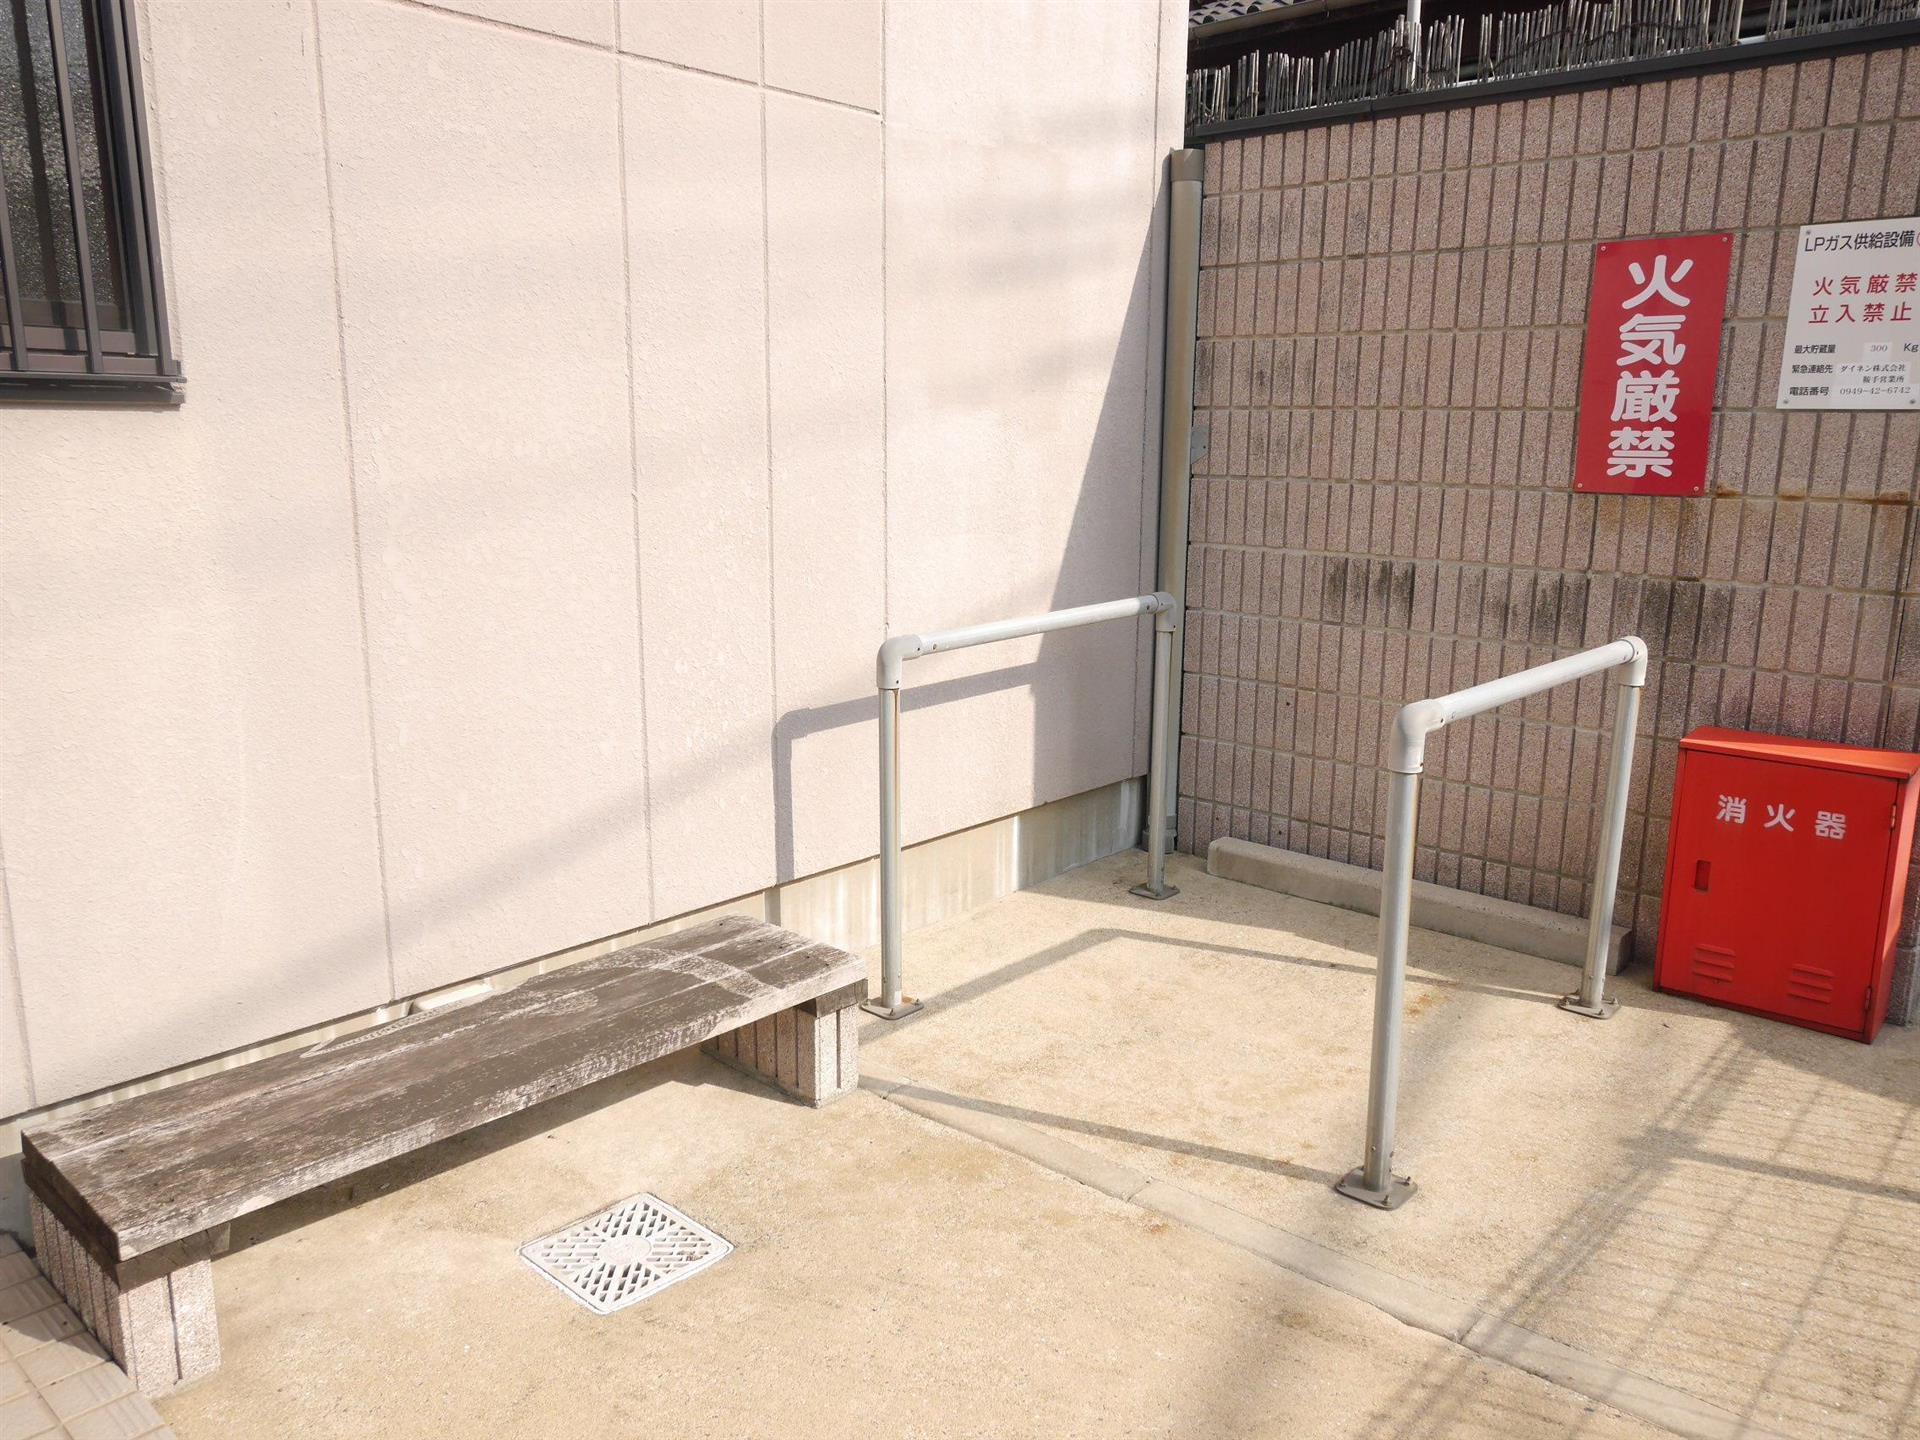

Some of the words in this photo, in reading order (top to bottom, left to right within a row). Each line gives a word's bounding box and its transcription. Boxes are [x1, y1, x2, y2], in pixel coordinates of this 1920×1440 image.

[1804, 230, 1915, 252] LPガス供給設備
[1812, 272, 1918, 296] 火気厳禁
[1808, 301, 1913, 324] 立入禁止
[1606, 254, 1694, 478] 火気厳禁
[1791, 364, 1833, 374] 緊急連絡先
[1789, 386, 1830, 396] 電話番号
[1715, 794, 1847, 841] 消火器
